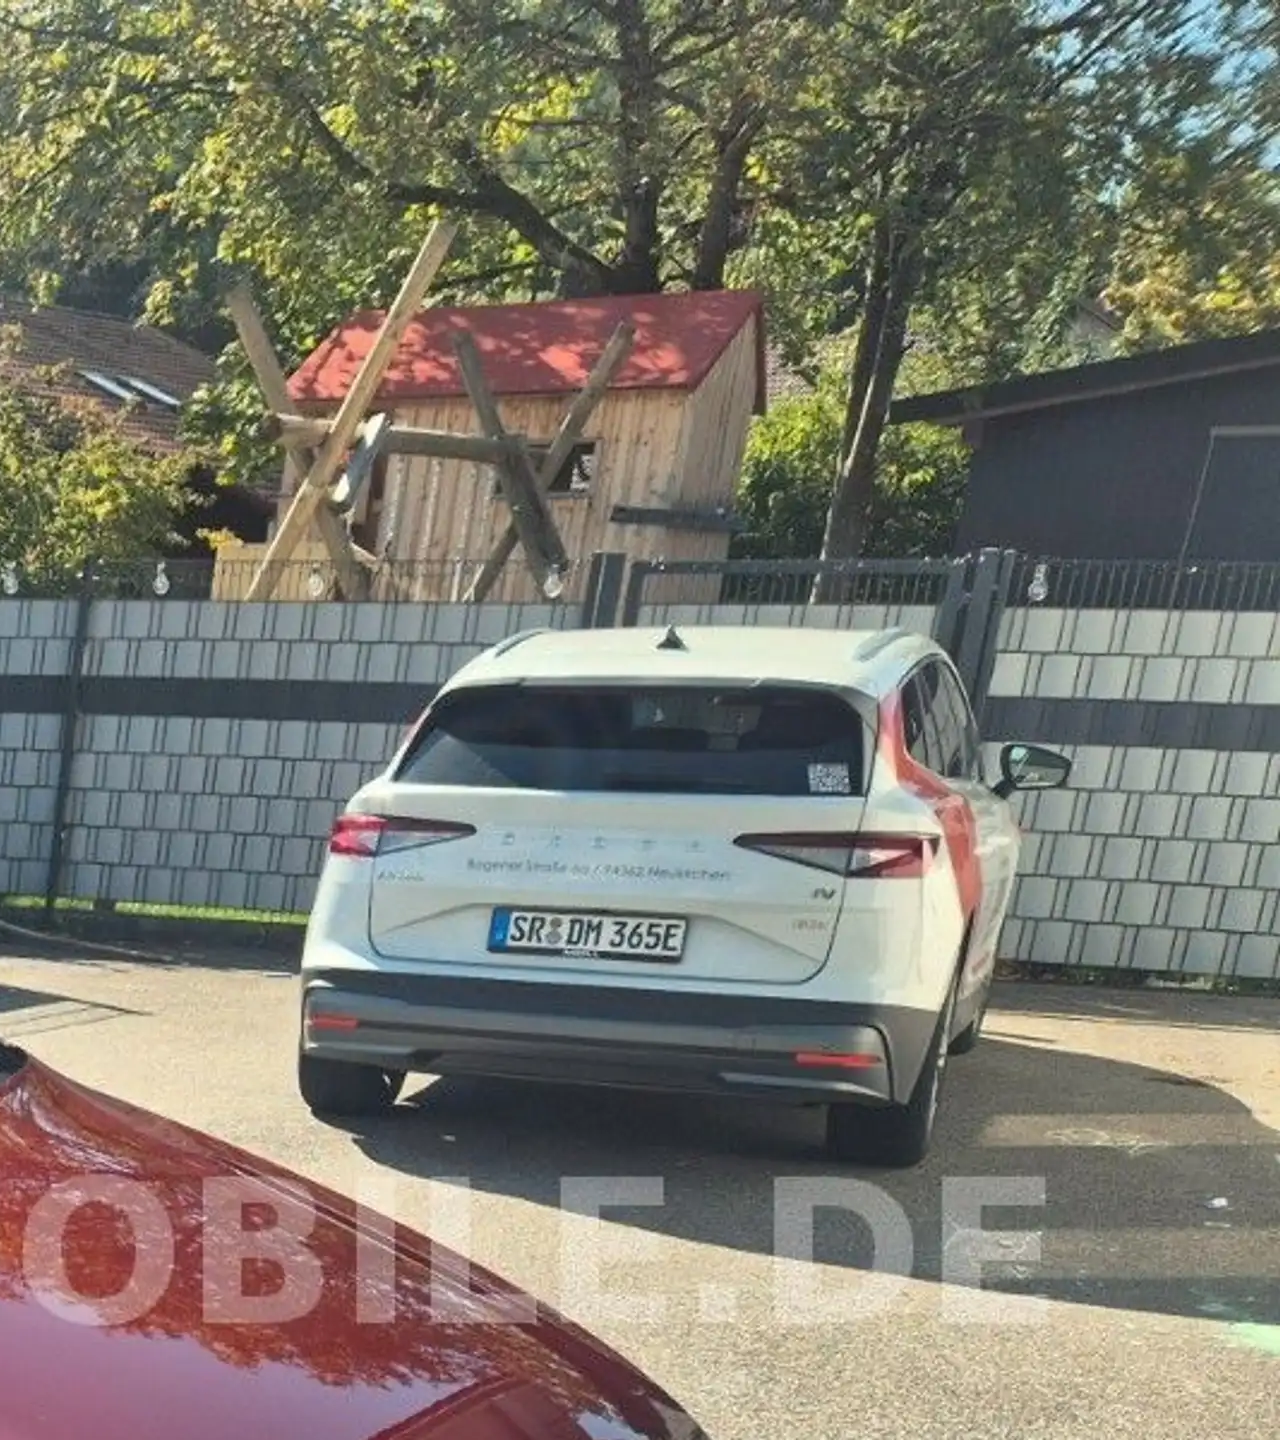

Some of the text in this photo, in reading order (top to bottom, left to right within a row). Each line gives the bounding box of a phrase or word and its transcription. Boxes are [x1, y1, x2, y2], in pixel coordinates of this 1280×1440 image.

[509, 915, 683, 952] SR DM 365E
